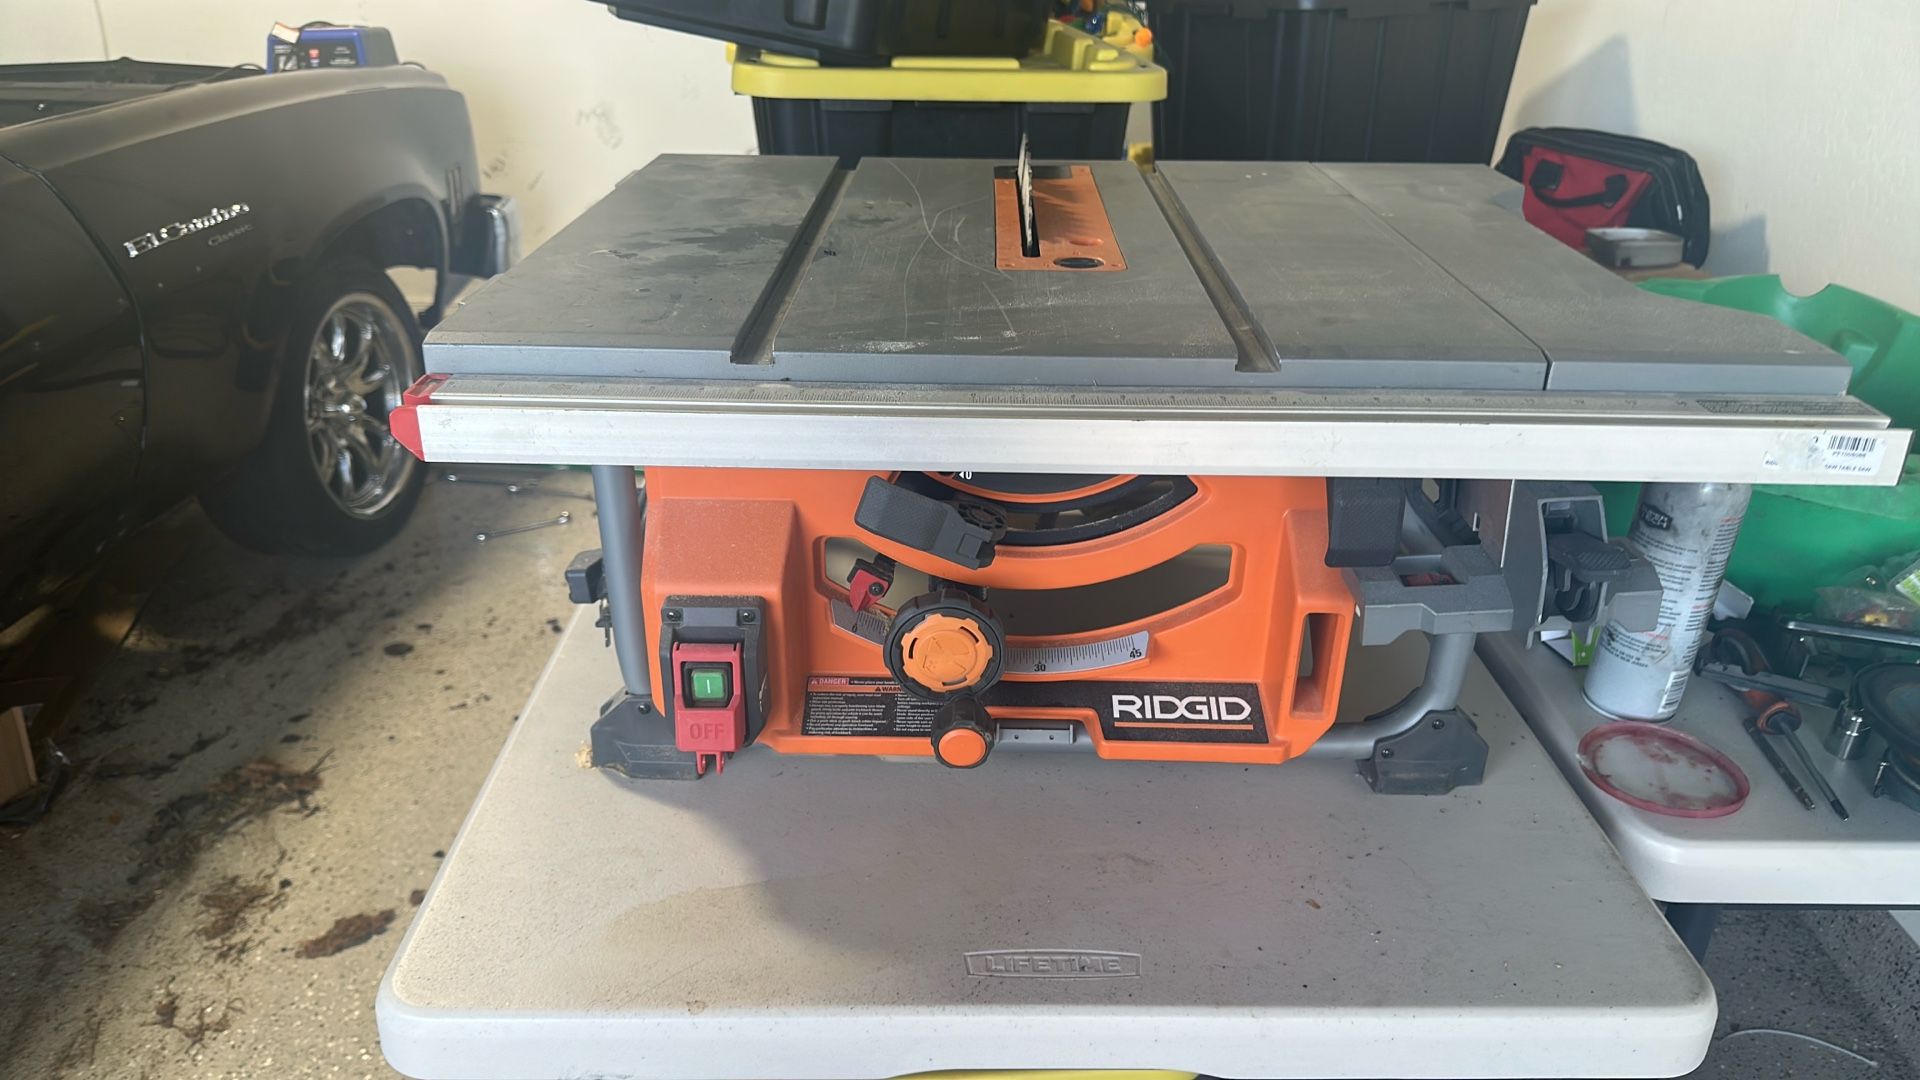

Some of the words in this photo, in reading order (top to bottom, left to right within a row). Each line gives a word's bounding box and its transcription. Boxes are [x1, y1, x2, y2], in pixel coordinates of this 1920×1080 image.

[1129, 648, 1142, 659] 45
[1033, 663, 1046, 672] 30
[818, 677, 848, 686] DANGER
[1112, 694, 1252, 721] RIDGID
[689, 723, 725, 740] OFF
[985, 954, 1122, 974] LIFETIME
